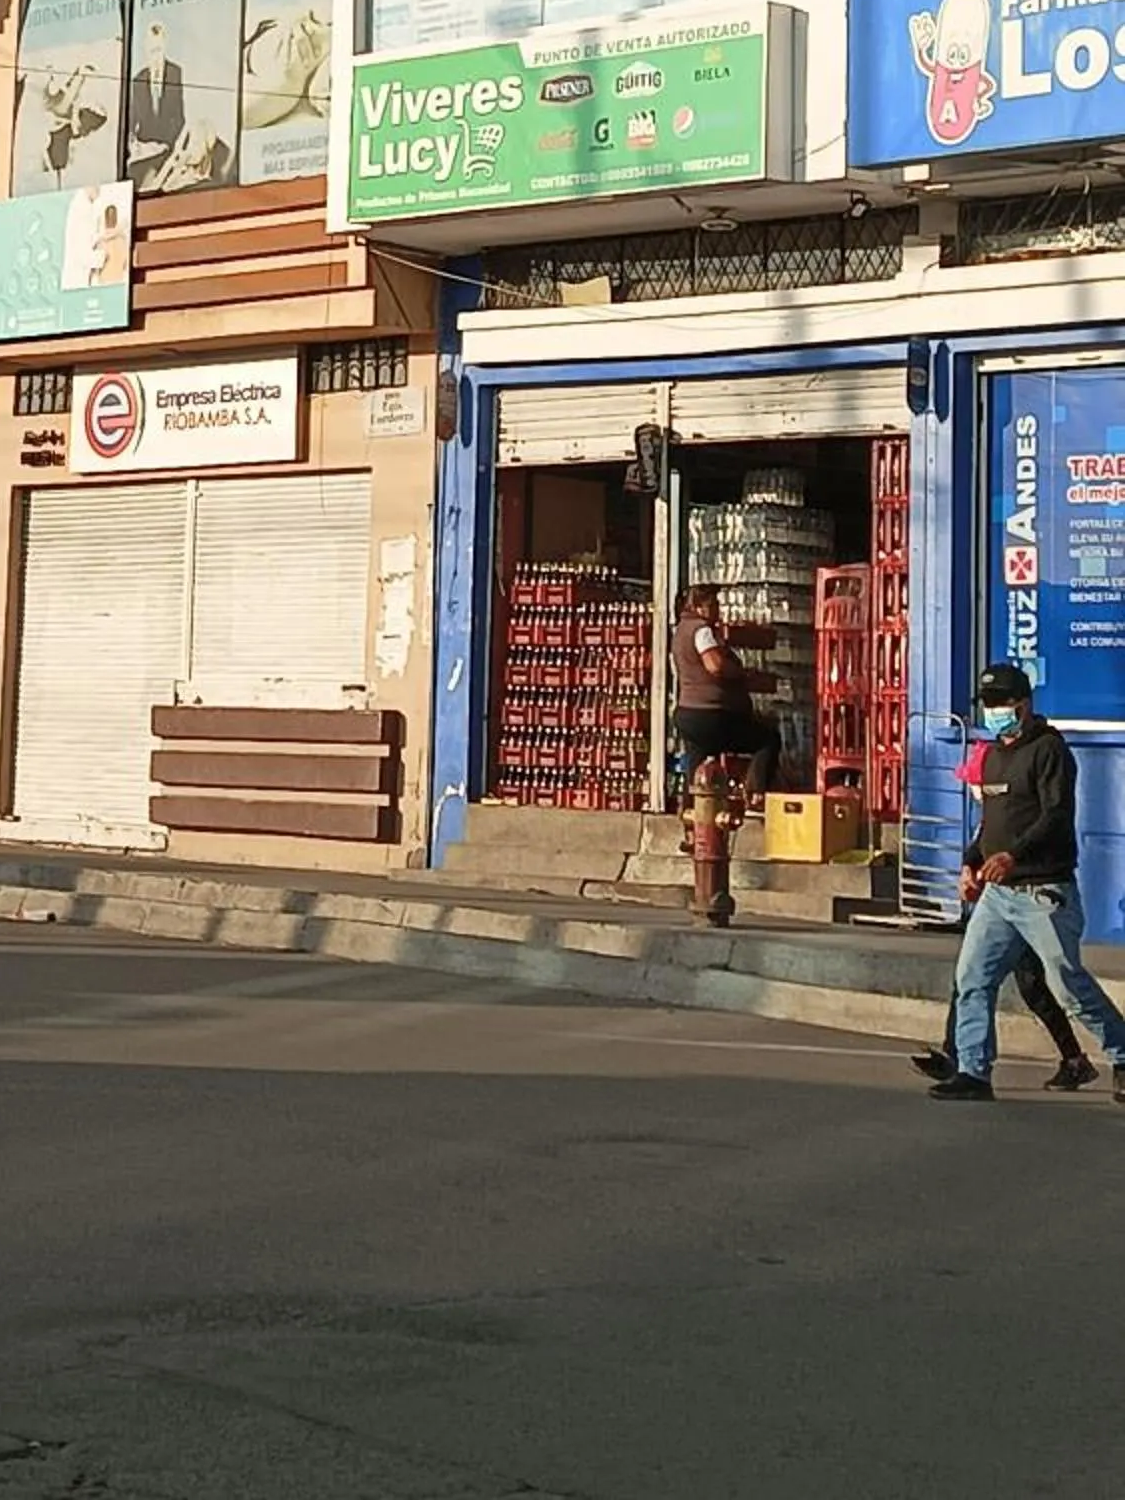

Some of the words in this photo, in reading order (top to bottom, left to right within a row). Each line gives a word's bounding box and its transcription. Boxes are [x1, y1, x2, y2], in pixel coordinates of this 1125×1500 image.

[534, 46, 583, 64] PUNTO
[585, 43, 602, 59] DE
[607, 36, 652, 55] VENTA
[657, 21, 752, 46] AUTORIZADO
[1002, 19, 1125, 99] Lo
[694, 67, 732, 82] BIELA
[361, 76, 523, 130] Viveres
[938, 99, 960, 125] A
[359, 133, 460, 183] Lucy
[156, 389, 217, 411] Empresa
[164, 409, 240, 432] RIOBAMBA
[244, 406, 273, 426] S.A.
[1006, 415, 1038, 543] ANDES
